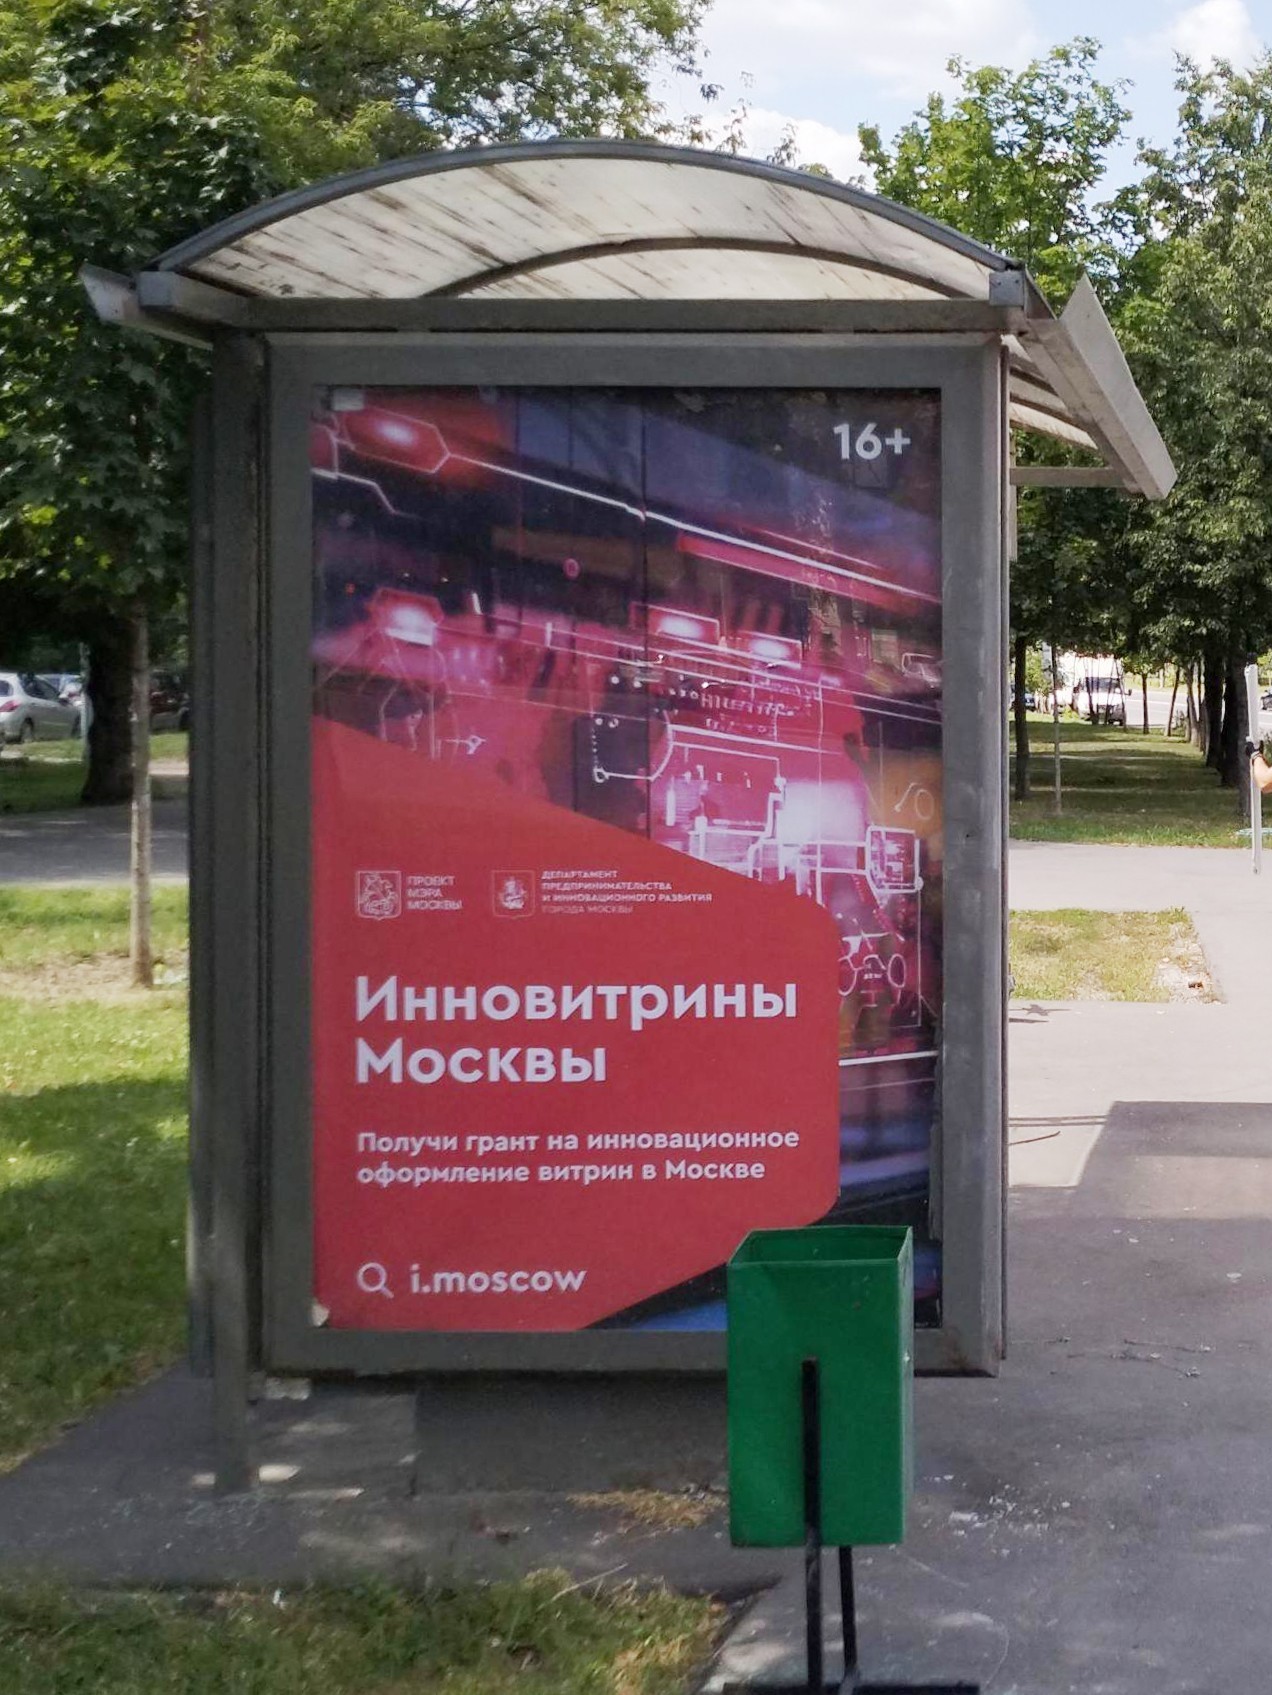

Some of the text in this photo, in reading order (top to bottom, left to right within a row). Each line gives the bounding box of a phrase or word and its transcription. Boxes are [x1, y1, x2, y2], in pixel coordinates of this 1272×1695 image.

[833, 422, 911, 460] 16+
[407, 876, 455, 886] ПРОЕКТ
[541, 870, 618, 880] ДЕПАРТАМЕНТ
[541, 882, 672, 891] ПРЕДПРИНИМАТЕЛЬСТВА
[407, 900, 463, 910] МОСКВЫ
[554, 893, 656, 903] ИННОВАЦИОННОГО
[659, 893, 712, 903] РАЗВИТИЯ
[588, 905, 633, 914] МОСКВЫ
[356, 975, 797, 1031] Инновитрины
[356, 1037, 606, 1084] Москвы
[358, 1131, 799, 1156] Получи грант на инновационное
[358, 1159, 766, 1188] оформление витрин в Москве
[410, 1263, 586, 1293] i.moscow
